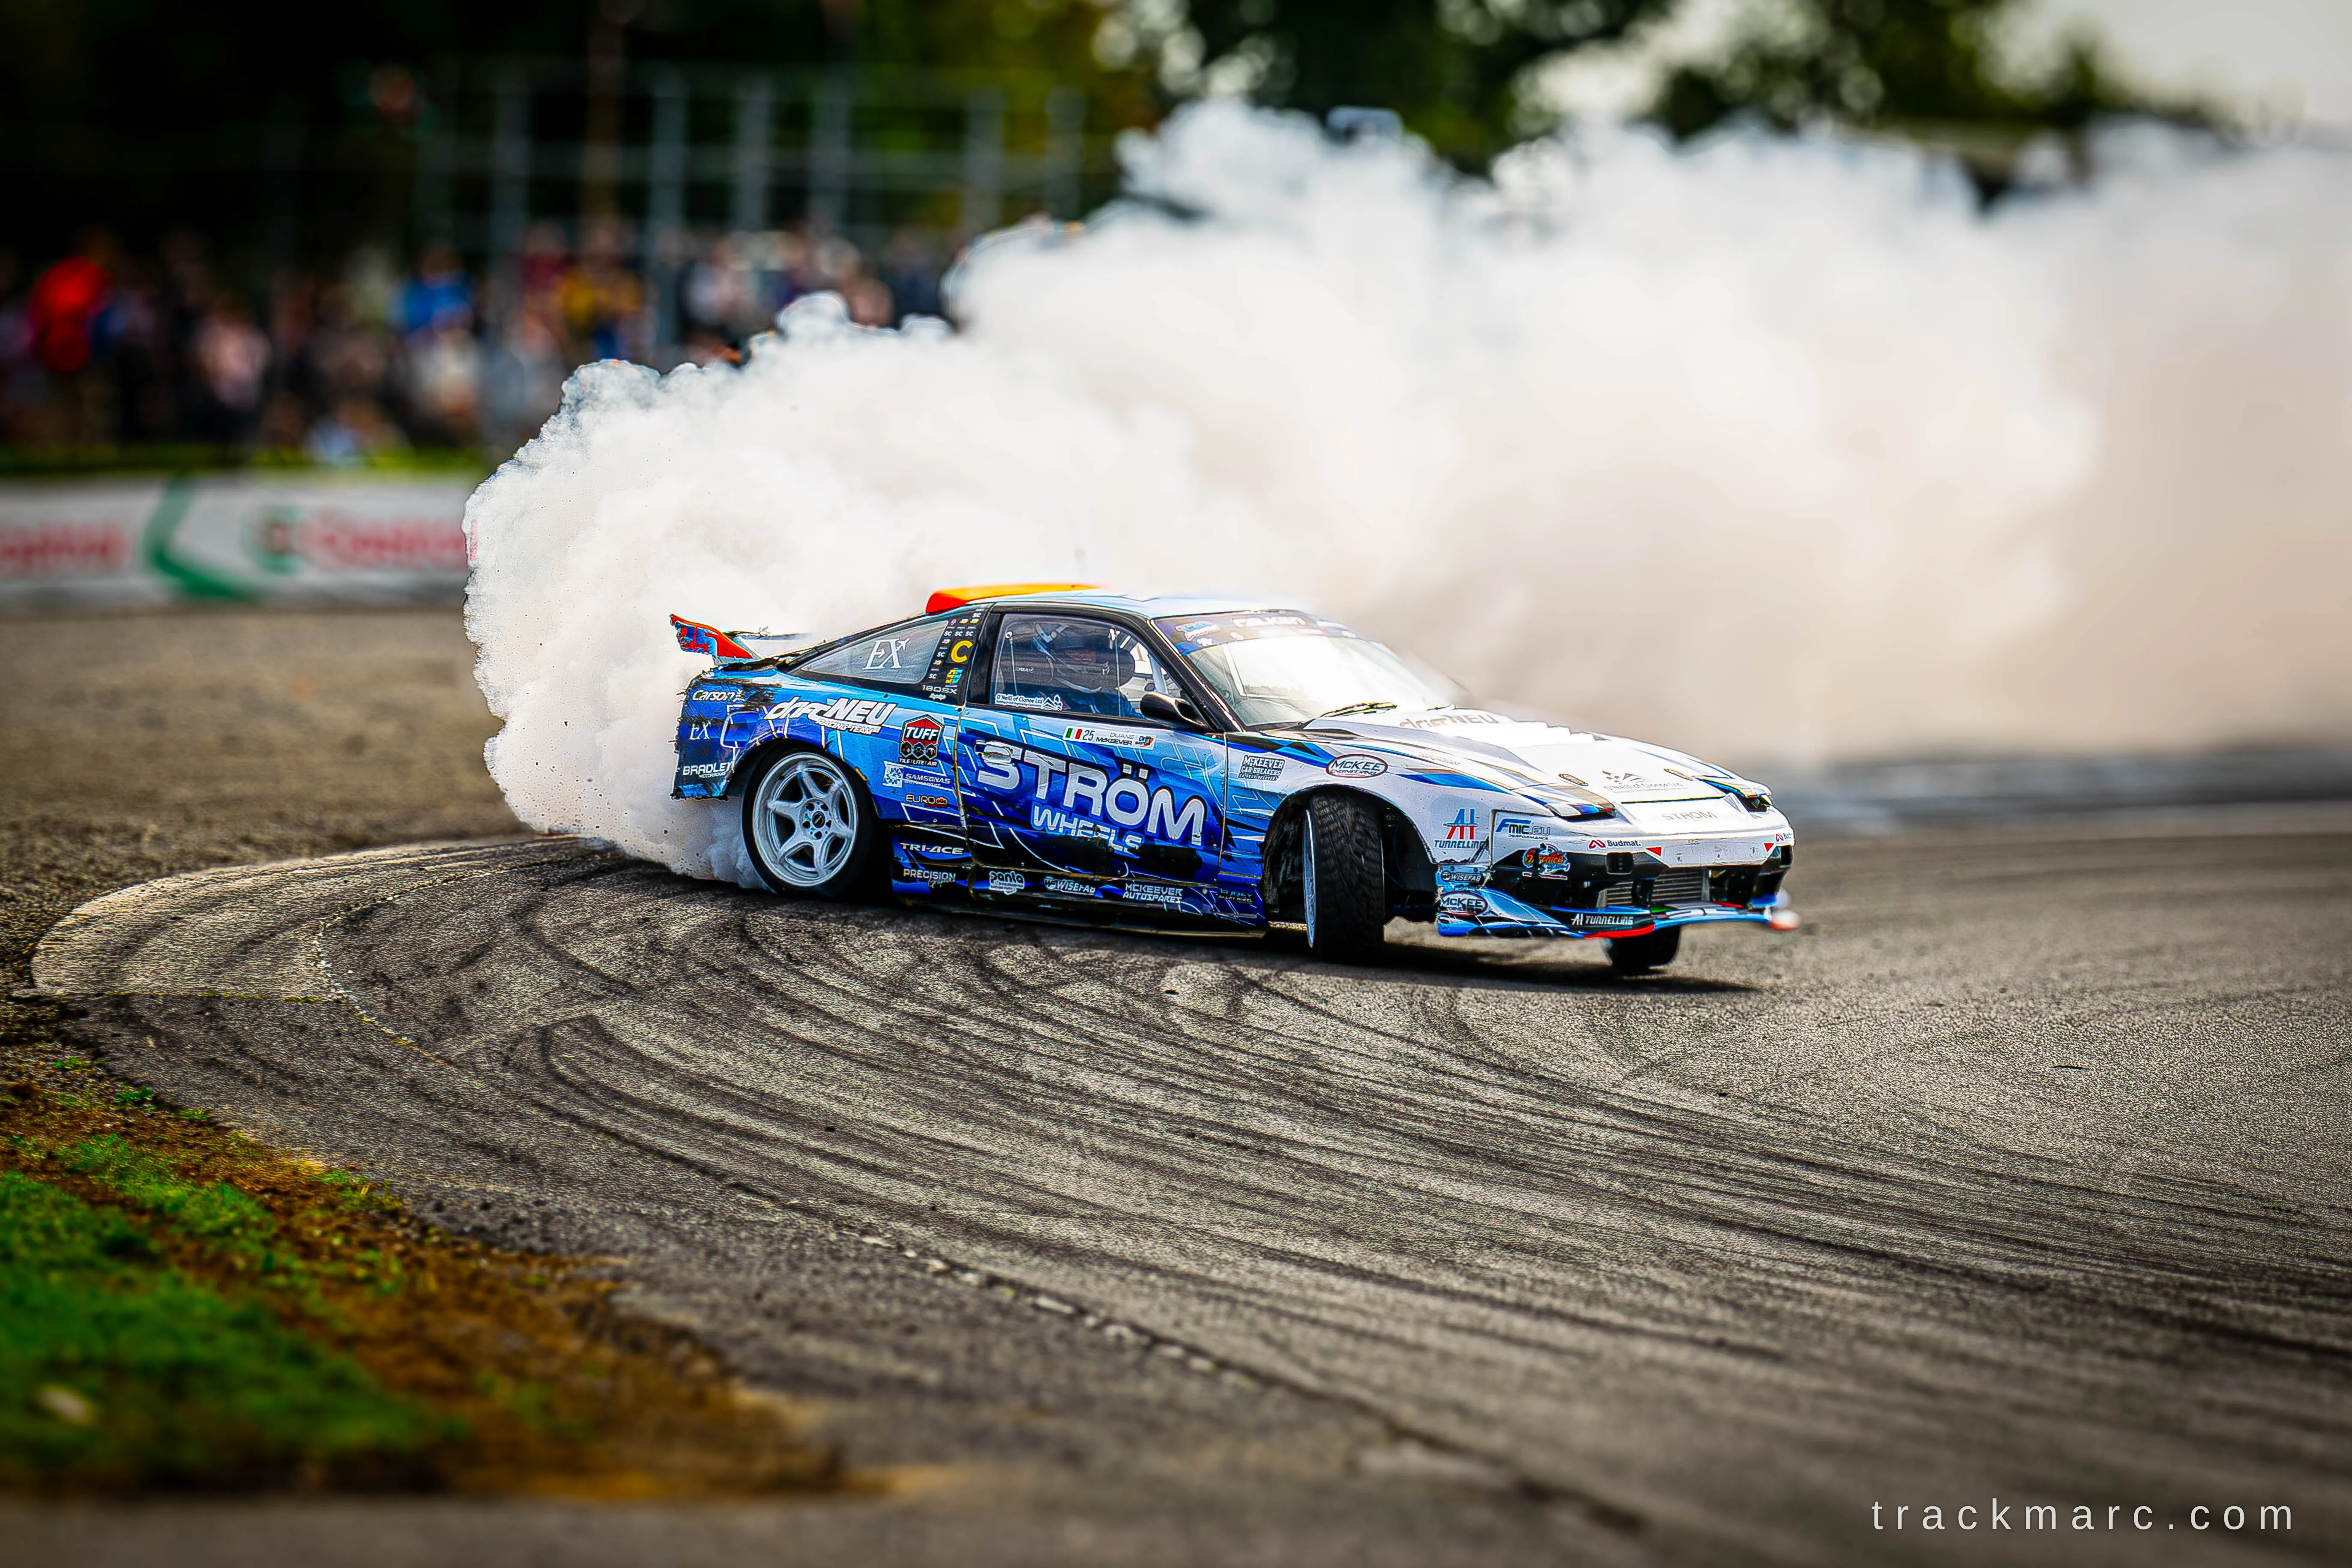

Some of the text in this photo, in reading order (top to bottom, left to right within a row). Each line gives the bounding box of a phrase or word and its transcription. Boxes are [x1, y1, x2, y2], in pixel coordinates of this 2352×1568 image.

[951, 640, 973, 663] C
[922, 685, 958, 695] 180SX
[905, 727, 939, 740] TUFF
[1082, 729, 1095, 741] 25
[682, 761, 733, 776] BRADLEY
[906, 773, 951, 784] SAMSONAS
[906, 794, 936, 804] EURO
[978, 742, 1205, 846] STRÖM
[900, 842, 964, 855] TRI-ACE
[903, 868, 956, 882] PRECISION
[1122, 891, 1182, 904] AUTOSPARES
